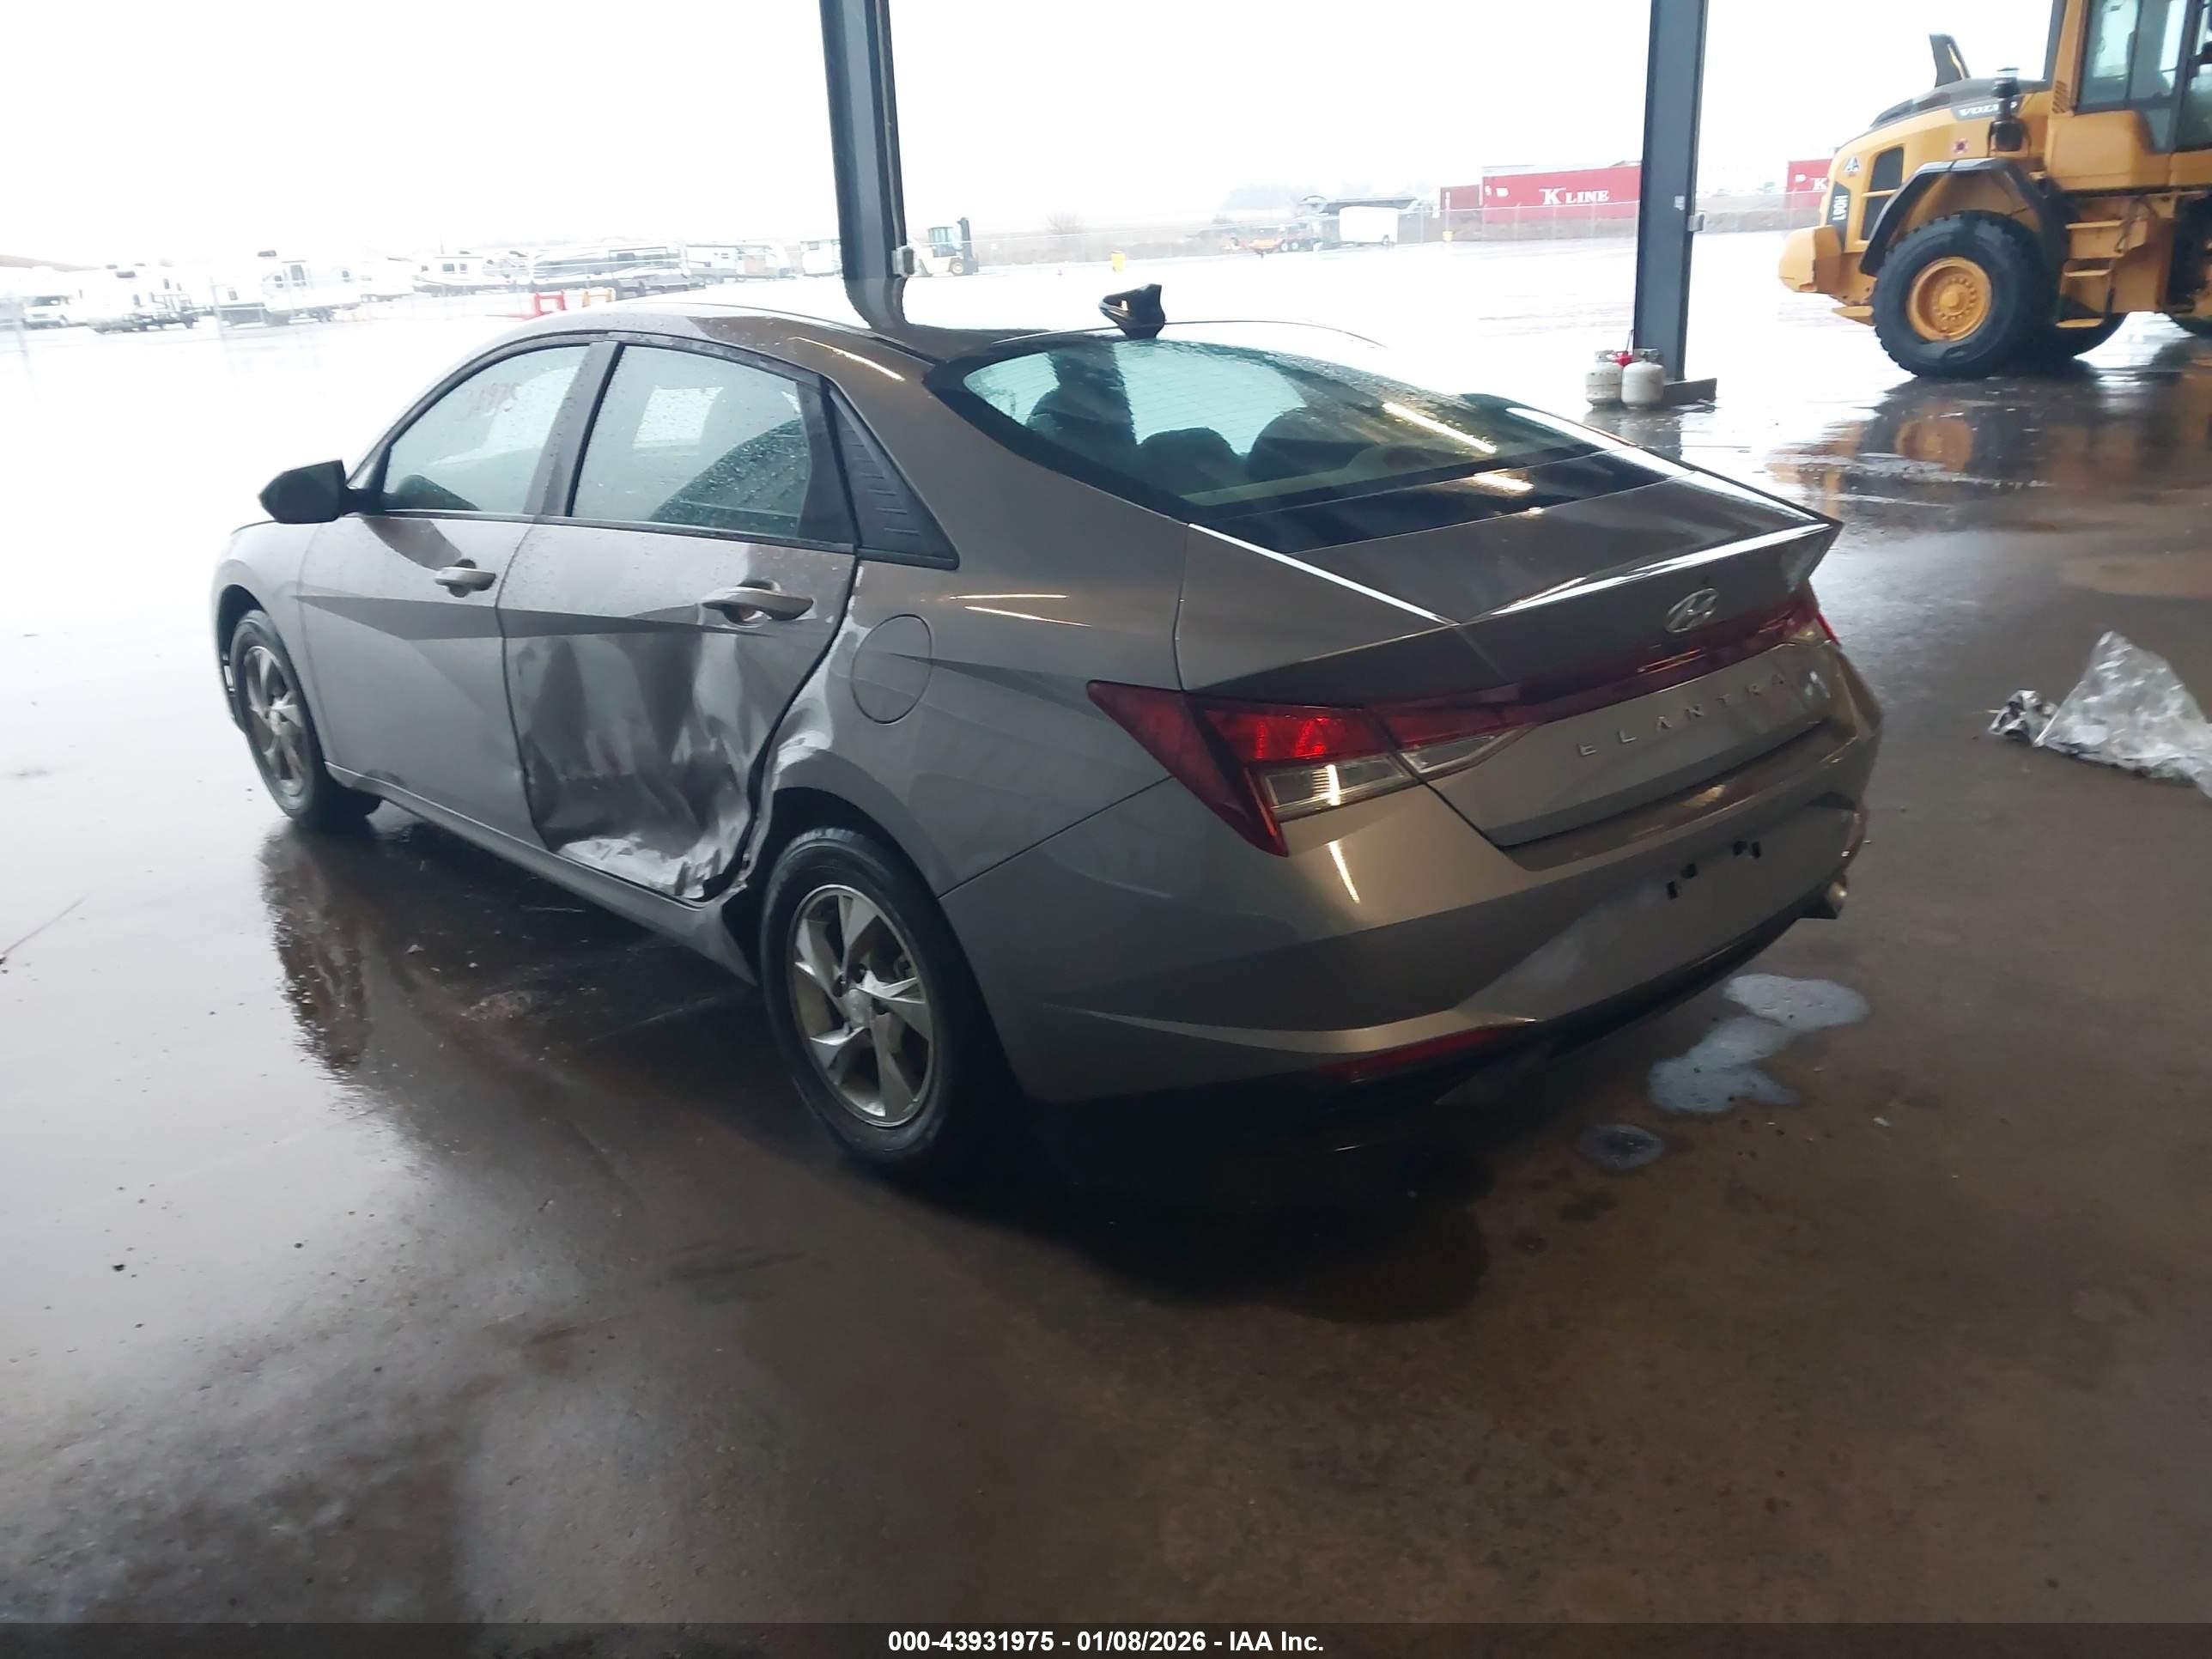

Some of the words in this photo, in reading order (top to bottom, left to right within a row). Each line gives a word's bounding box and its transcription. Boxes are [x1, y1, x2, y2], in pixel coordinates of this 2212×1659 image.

[1811, 177, 1828, 191] K
[1539, 187, 1566, 205] K
[1565, 190, 1610, 204] LINE
[1579, 672, 1784, 756] ELANTRA
